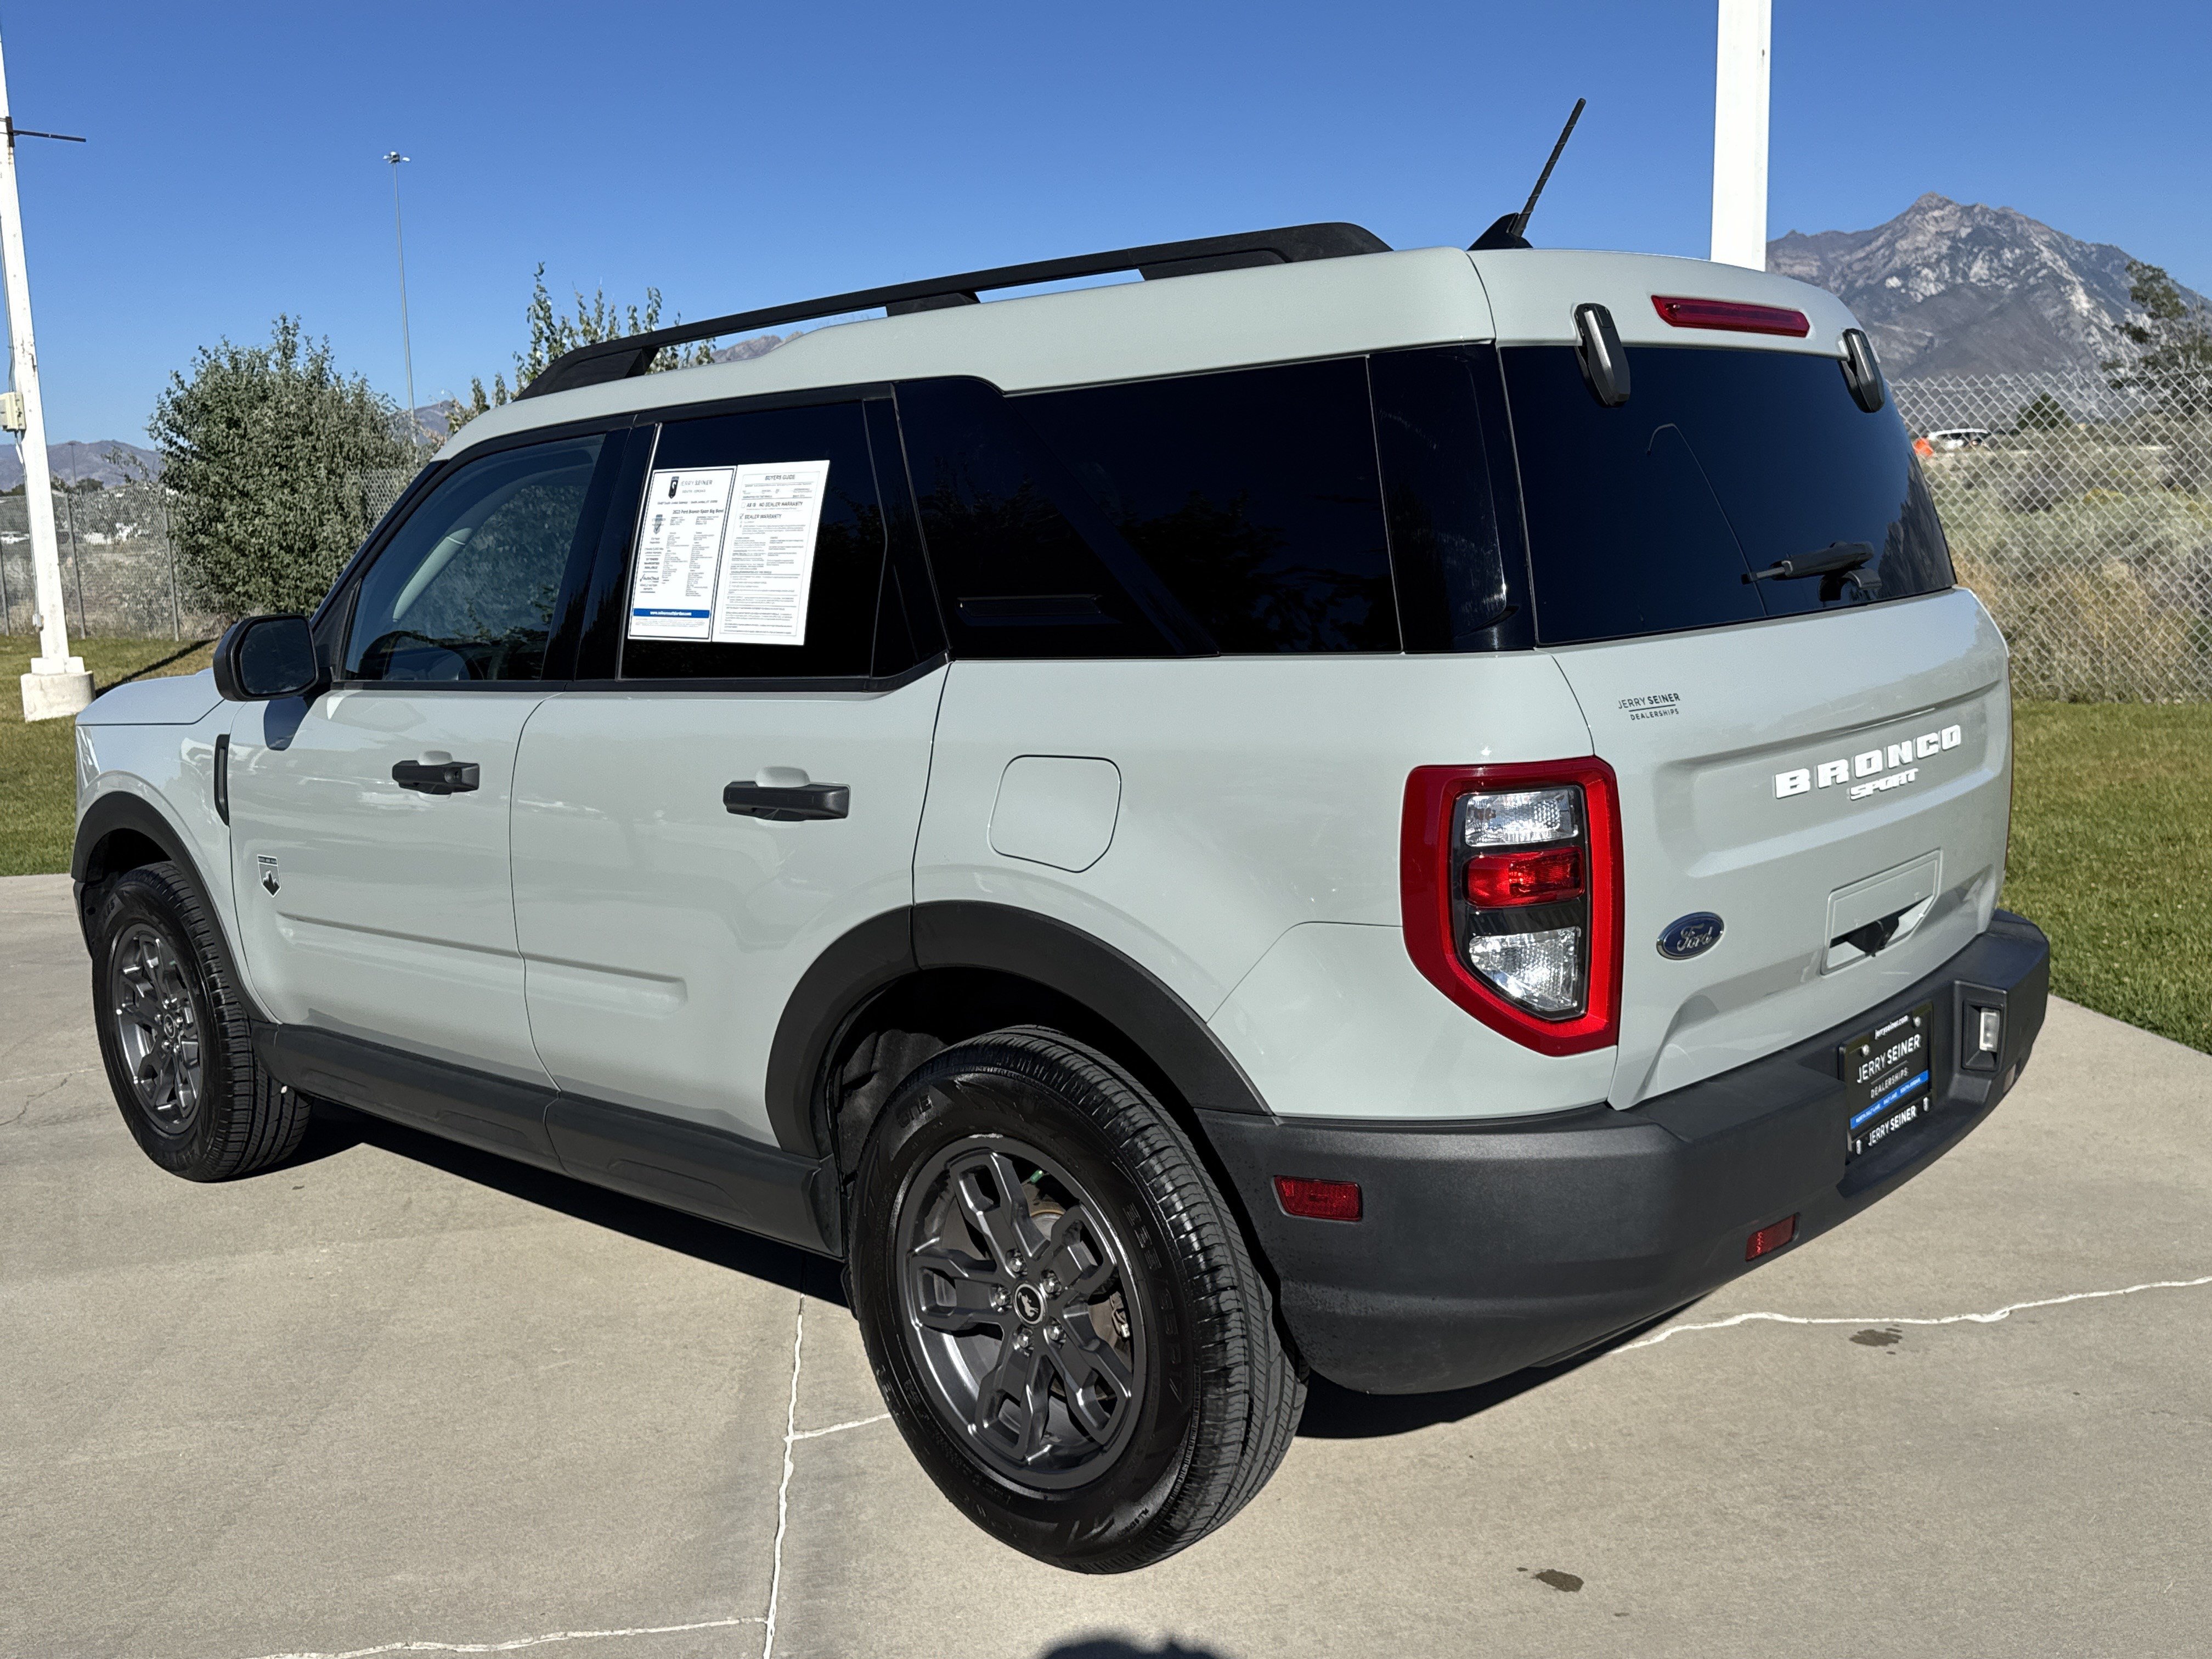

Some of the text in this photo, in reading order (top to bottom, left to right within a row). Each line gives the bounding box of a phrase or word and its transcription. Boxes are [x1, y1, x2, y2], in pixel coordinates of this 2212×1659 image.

[1618, 693, 1680, 709] JERRY SEINER
[1630, 708, 1679, 720] DEALERSHIPS
[1773, 724, 1961, 799] BRONCO
[1848, 768, 1918, 800] SPORT
[1677, 923, 1713, 951] Ford
[1857, 1034, 1921, 1084] JERRY SEINER
[1871, 1067, 1909, 1098] DEALERSHIPS
[1868, 1105, 1917, 1146] JERRY SEINER
